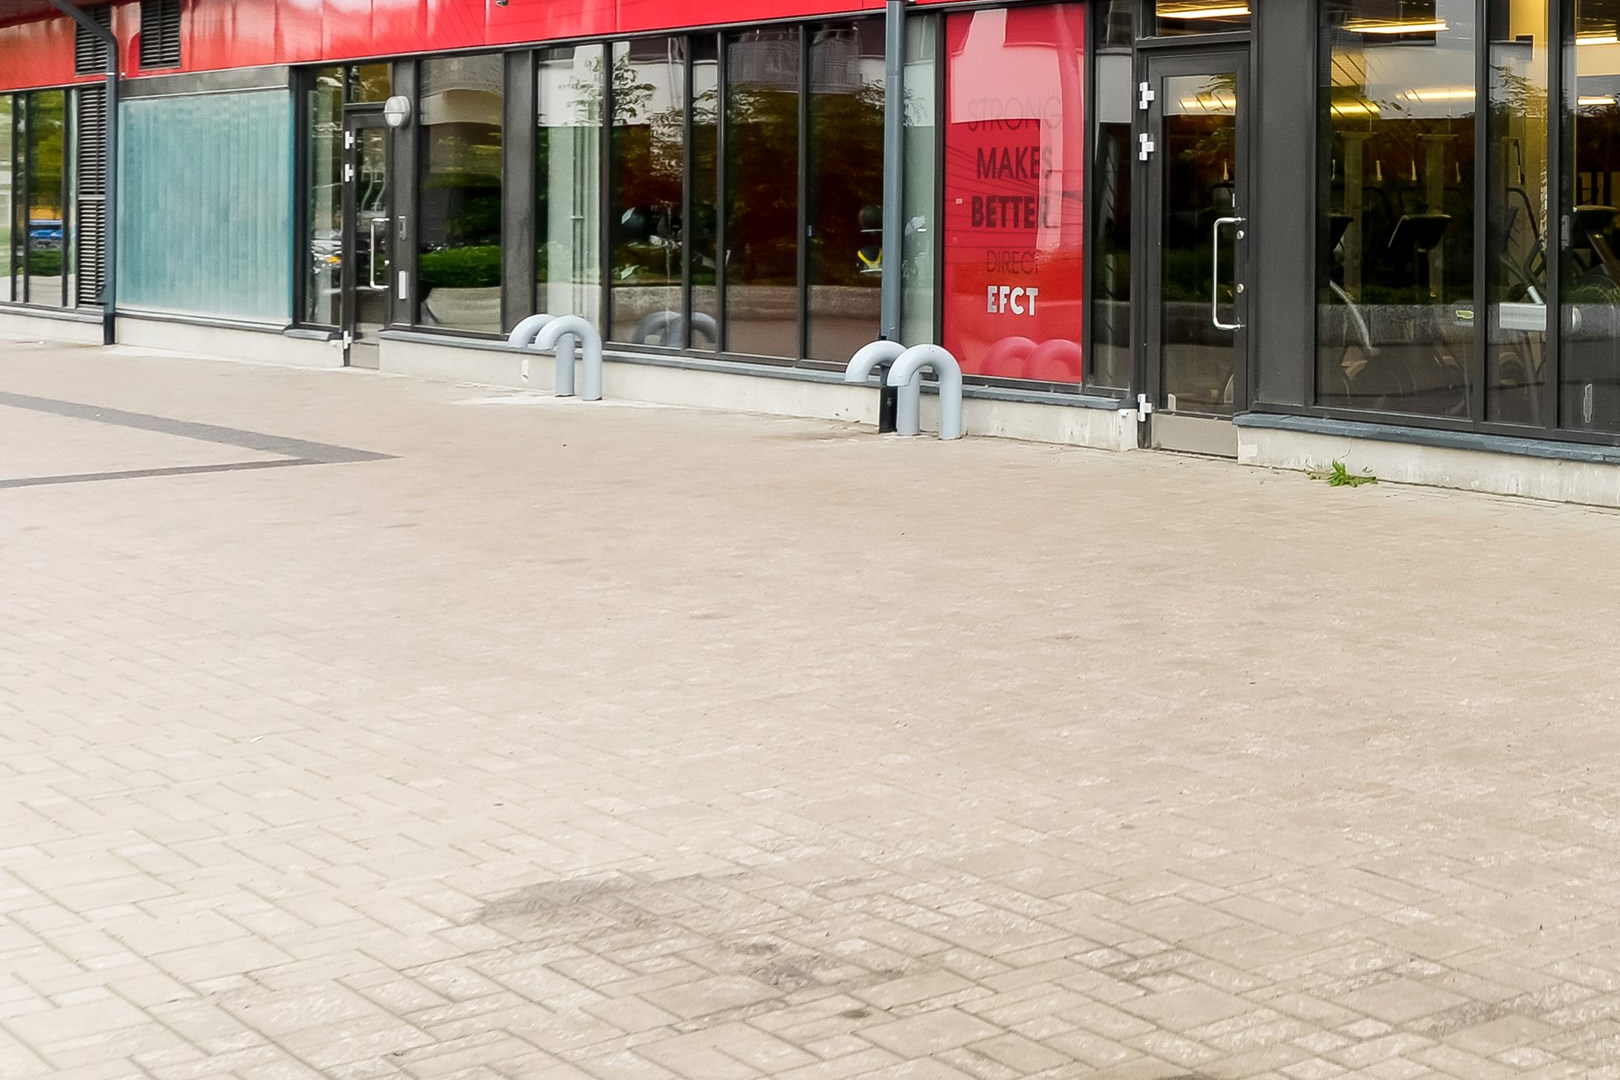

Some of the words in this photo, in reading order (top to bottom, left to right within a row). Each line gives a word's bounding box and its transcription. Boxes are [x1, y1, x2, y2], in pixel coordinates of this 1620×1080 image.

[968, 96, 1062, 132] STRONG
[977, 146, 1052, 180] MAKES
[987, 285, 1039, 317] EFCT
